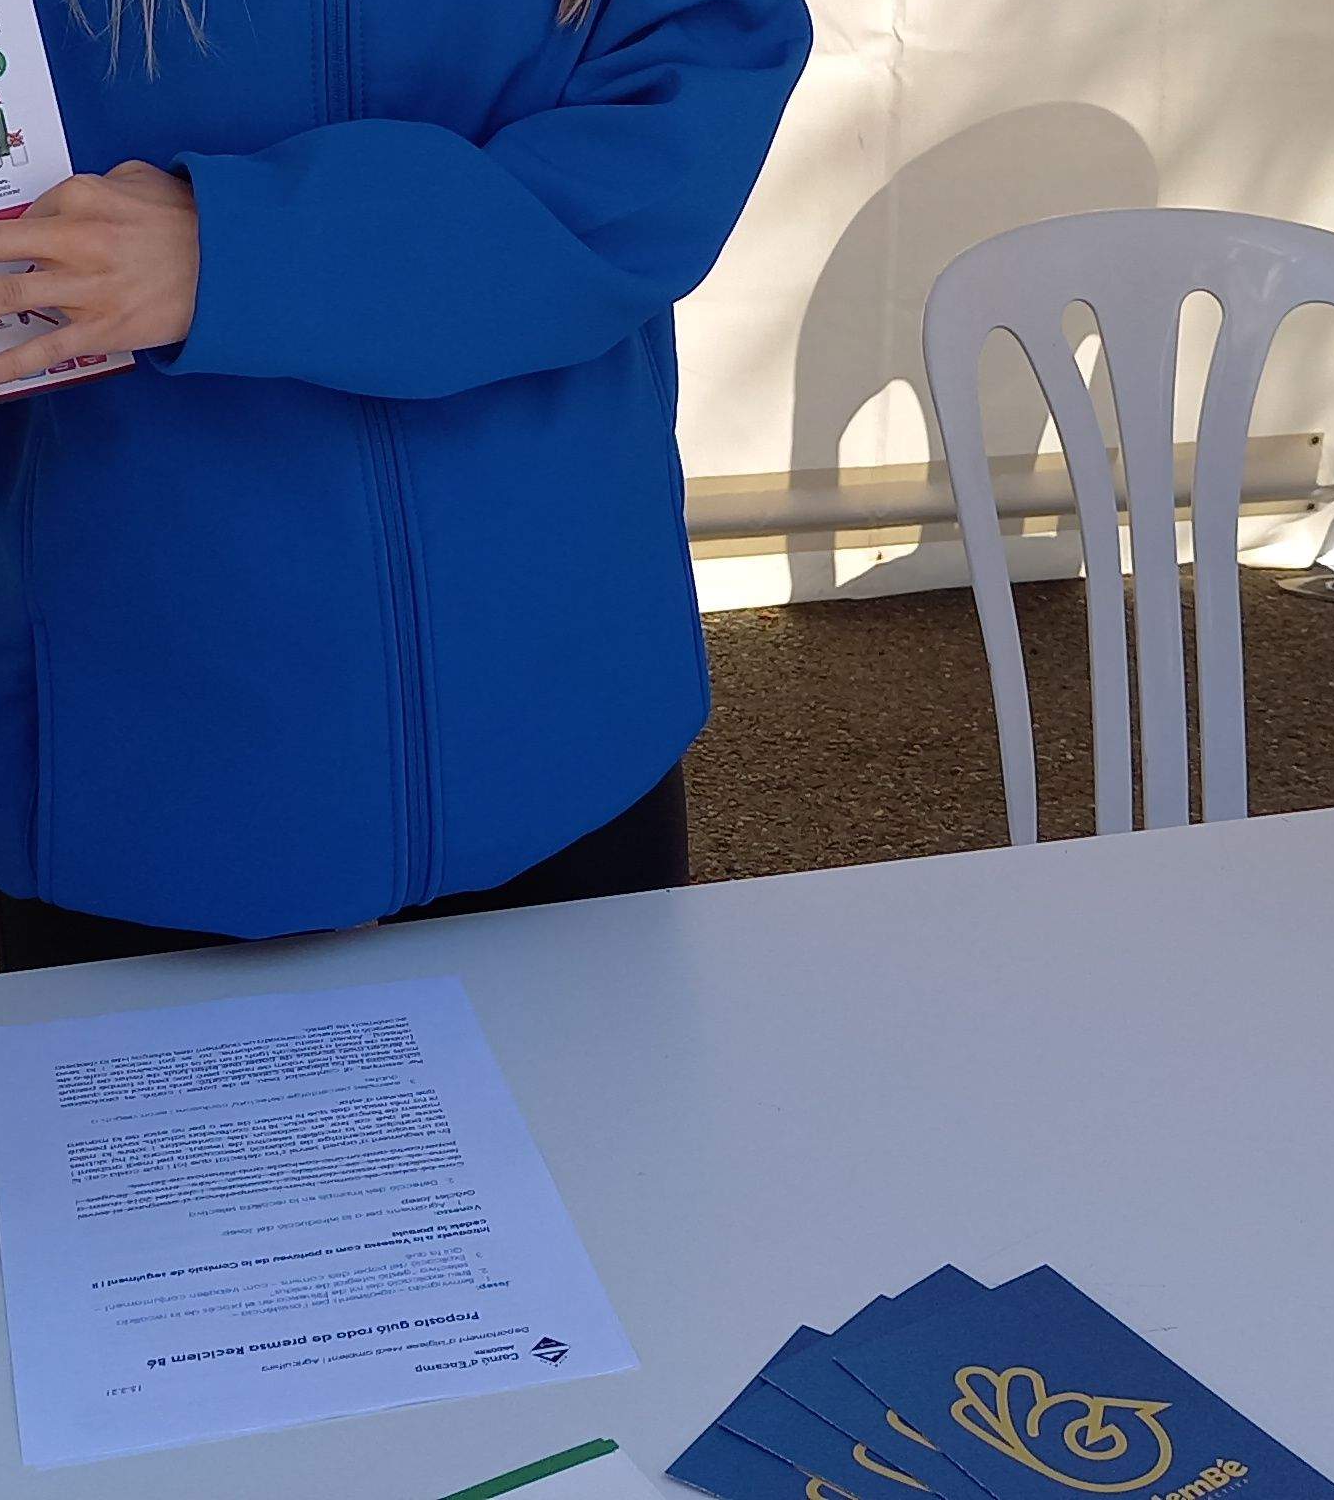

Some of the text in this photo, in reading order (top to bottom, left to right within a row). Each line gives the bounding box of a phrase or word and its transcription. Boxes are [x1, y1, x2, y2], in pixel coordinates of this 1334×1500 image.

[376, 1316, 410, 1338] guió
[413, 1309, 480, 1331] Proposta
[248, 1331, 307, 1353] premsa
[310, 1330, 332, 1346] de
[336, 1323, 373, 1342] roda
[170, 1344, 244, 1366] Reciclem
[414, 1355, 479, 1375] d'Encamp
